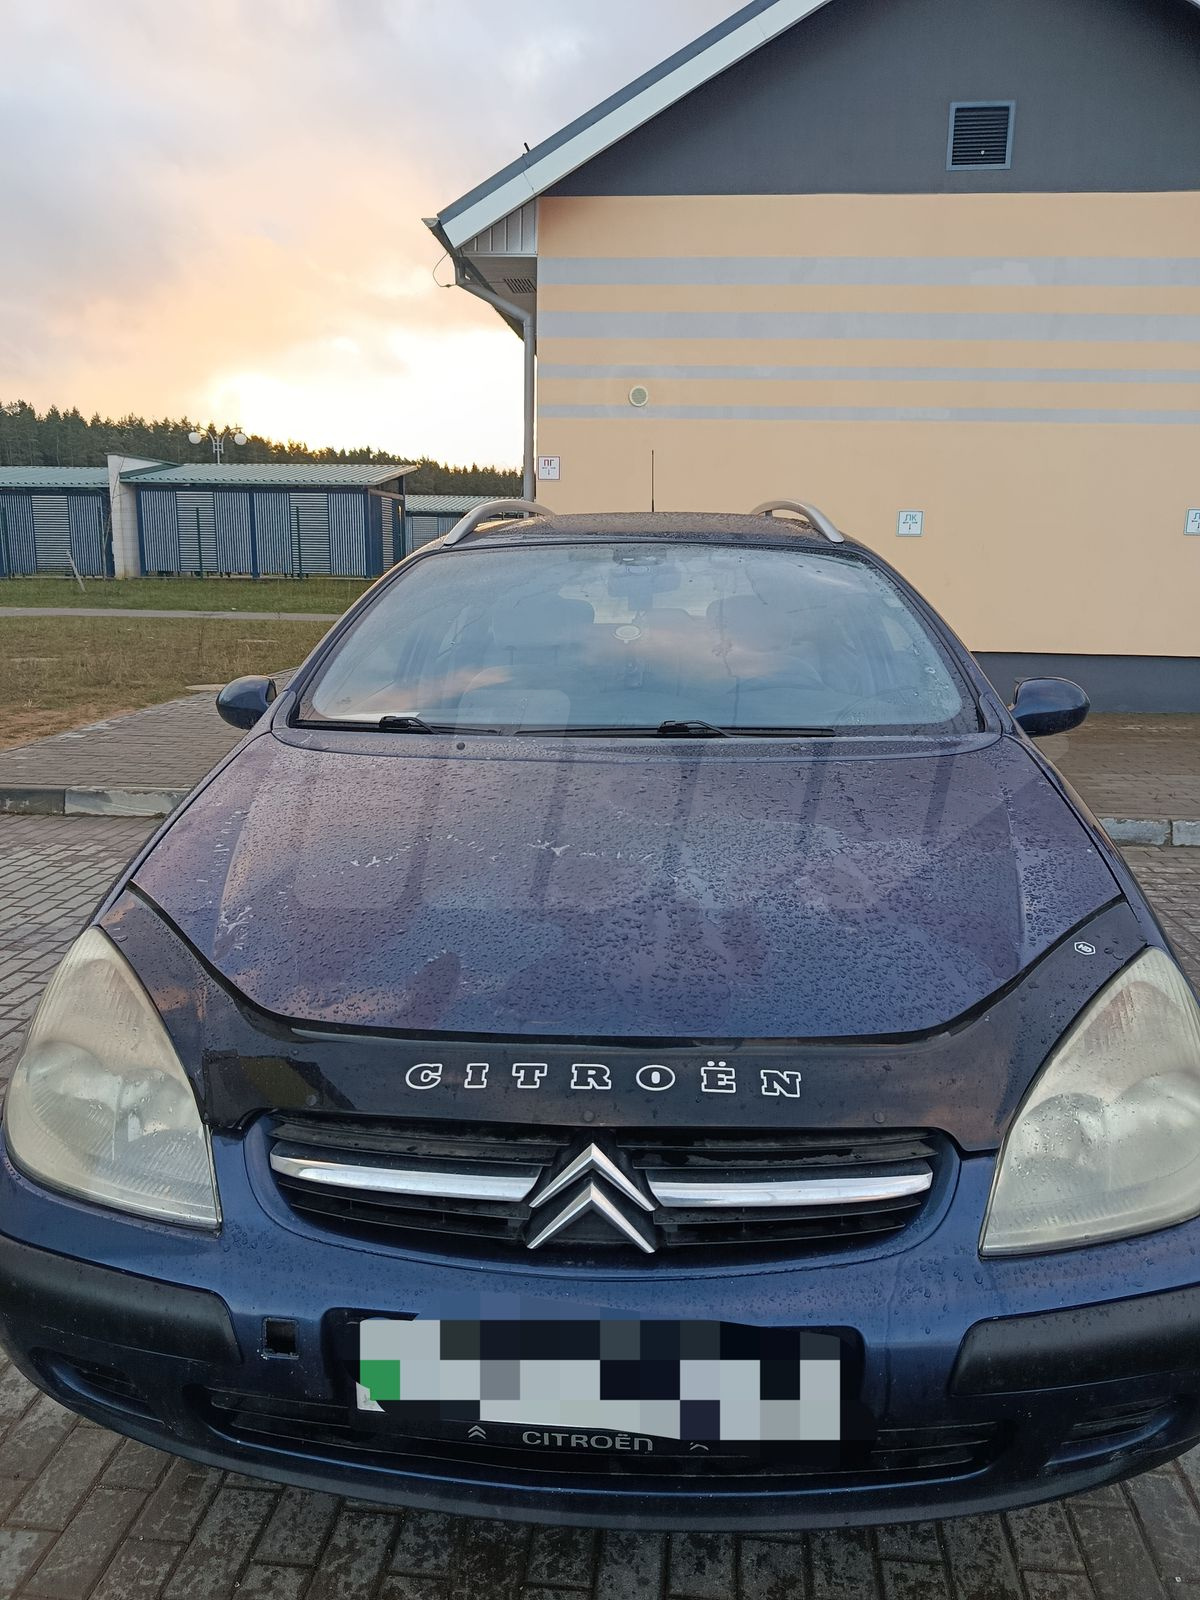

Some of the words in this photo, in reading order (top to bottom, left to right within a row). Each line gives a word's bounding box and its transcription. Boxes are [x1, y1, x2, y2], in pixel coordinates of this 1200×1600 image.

[543, 459, 555, 467] ПГ
[904, 513, 917, 521] ЛК
[405, 1060, 801, 1098] CITROËN
